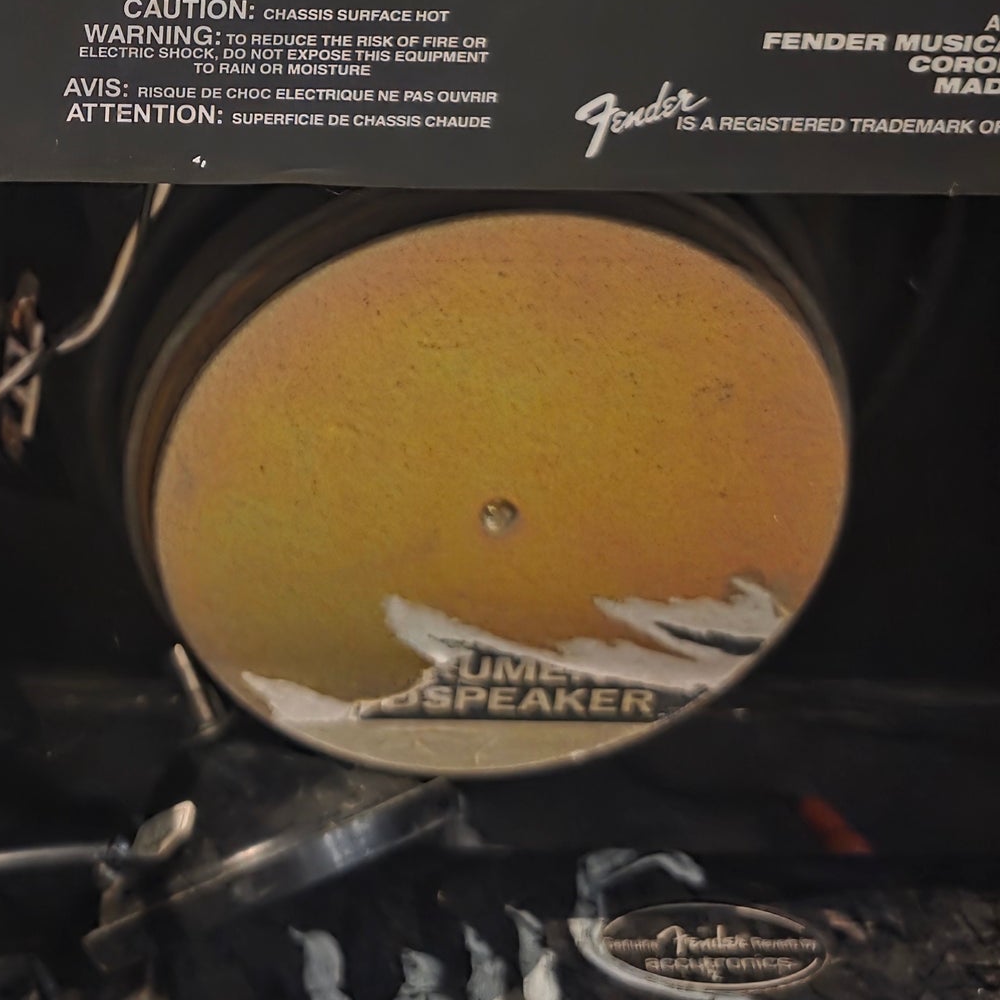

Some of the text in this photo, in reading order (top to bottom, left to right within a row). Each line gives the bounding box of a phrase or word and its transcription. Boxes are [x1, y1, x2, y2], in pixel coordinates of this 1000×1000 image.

[263, 8, 334, 21] CHASSIS
[336, 9, 413, 22] SURFACE
[415, 10, 451, 22] HOT
[83, 23, 487, 49] WARNING: TO REDUCE THE RISK OF FIRE OR
[762, 32, 888, 52] FENDER
[79, 46, 490, 63] ELECTRIC SHOCK, DO NOT EXPOSE THIS EQUIPMENT
[193, 62, 371, 76] TO RAIN OR MOISTURE
[908, 55, 1000, 74] CORO
[63, 77, 498, 104] AVIS: RISQUE DE CHOC ELECTRIQUE NE PAS OUVRIR
[65, 102, 492, 129] ATTENTION: SUPERFICIE DE CHASSIS CHAUDE
[574, 80, 711, 159] Fender
[676, 115, 697, 131] IS
[699, 116, 715, 131] A
[718, 116, 846, 133] REGISTERED
[849, 118, 975, 134] TRADEMARK
